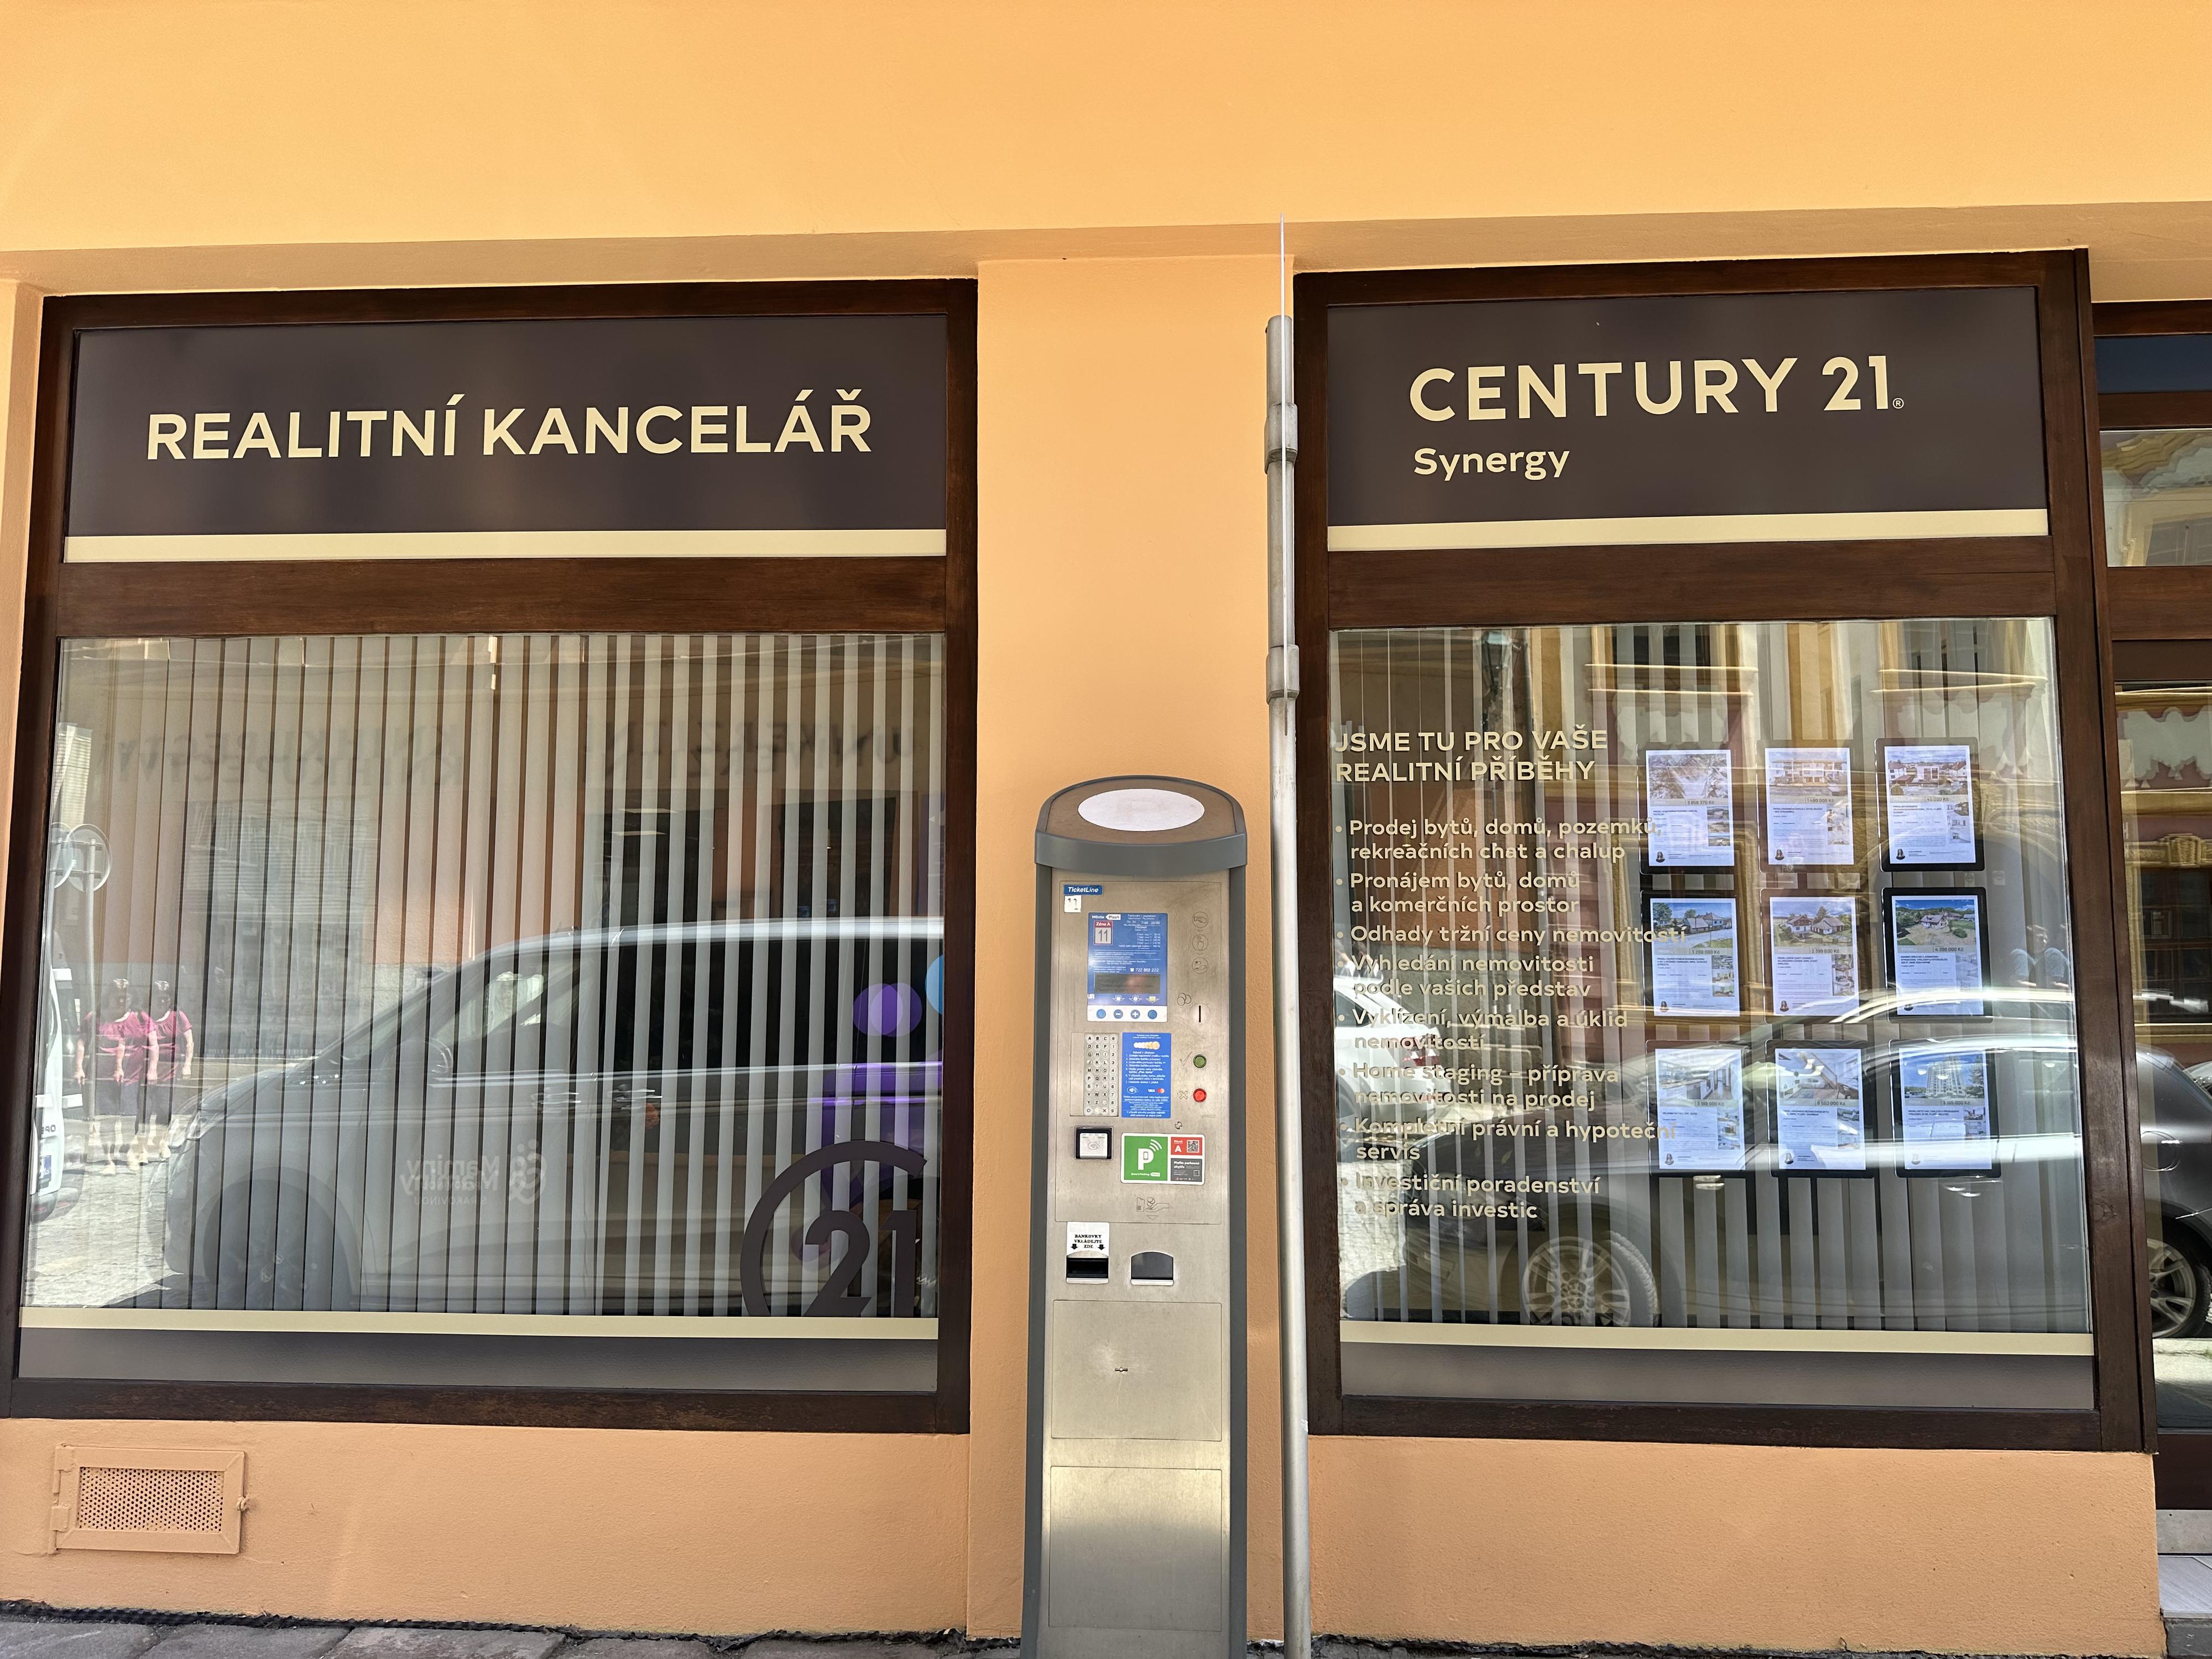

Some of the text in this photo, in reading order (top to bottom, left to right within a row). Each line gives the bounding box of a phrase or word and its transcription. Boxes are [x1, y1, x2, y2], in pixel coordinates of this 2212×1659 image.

[1410, 357, 1798, 421] CENTURY
[148, 389, 872, 460] REALITNÍ KANCELÁŘ
[1413, 448, 1571, 481] Synergy
[1335, 724, 1608, 753] JSME TU PRO VAŠE
[1335, 755, 1595, 782] REALITNÍ PŘÍBĚHY
[1349, 819, 1417, 839] Prodej
[1424, 818, 1479, 839] bytů,
[1485, 817, 1551, 838] domů,
[1559, 817, 1662, 840] pozemků,
[1351, 842, 1625, 863] rekreačních chat a chalup
[1350, 871, 1579, 892] Pronájem bytů, domů
[1352, 895, 1579, 916] a komerčních prostor
[1098, 929, 1108, 942] 11
[1351, 926, 1686, 946] Odhady tržní ceny nemovitostí
[1352, 955, 1593, 977] Vyhledání nemovitosti
[1354, 979, 1591, 1000] podle vašich představ
[1352, 1008, 1627, 1031] Vyklízení, výmalba a úklid
[1354, 1034, 1486, 1051] nemovitostí
[1352, 1063, 1416, 1079] Home
[1423, 1065, 1503, 1084] staging
[1527, 1065, 1619, 1086] příprava
[1355, 1088, 1595, 1111] nemovitosti na prodej
[1355, 1118, 1676, 1143] Kompletní právní a hypoteční
[1138, 1148, 1154, 1170] P
[1356, 1144, 1421, 1160] servis
[1355, 1172, 1601, 1196] Investiční poradenství
[1355, 1201, 1538, 1219] a správa investic
